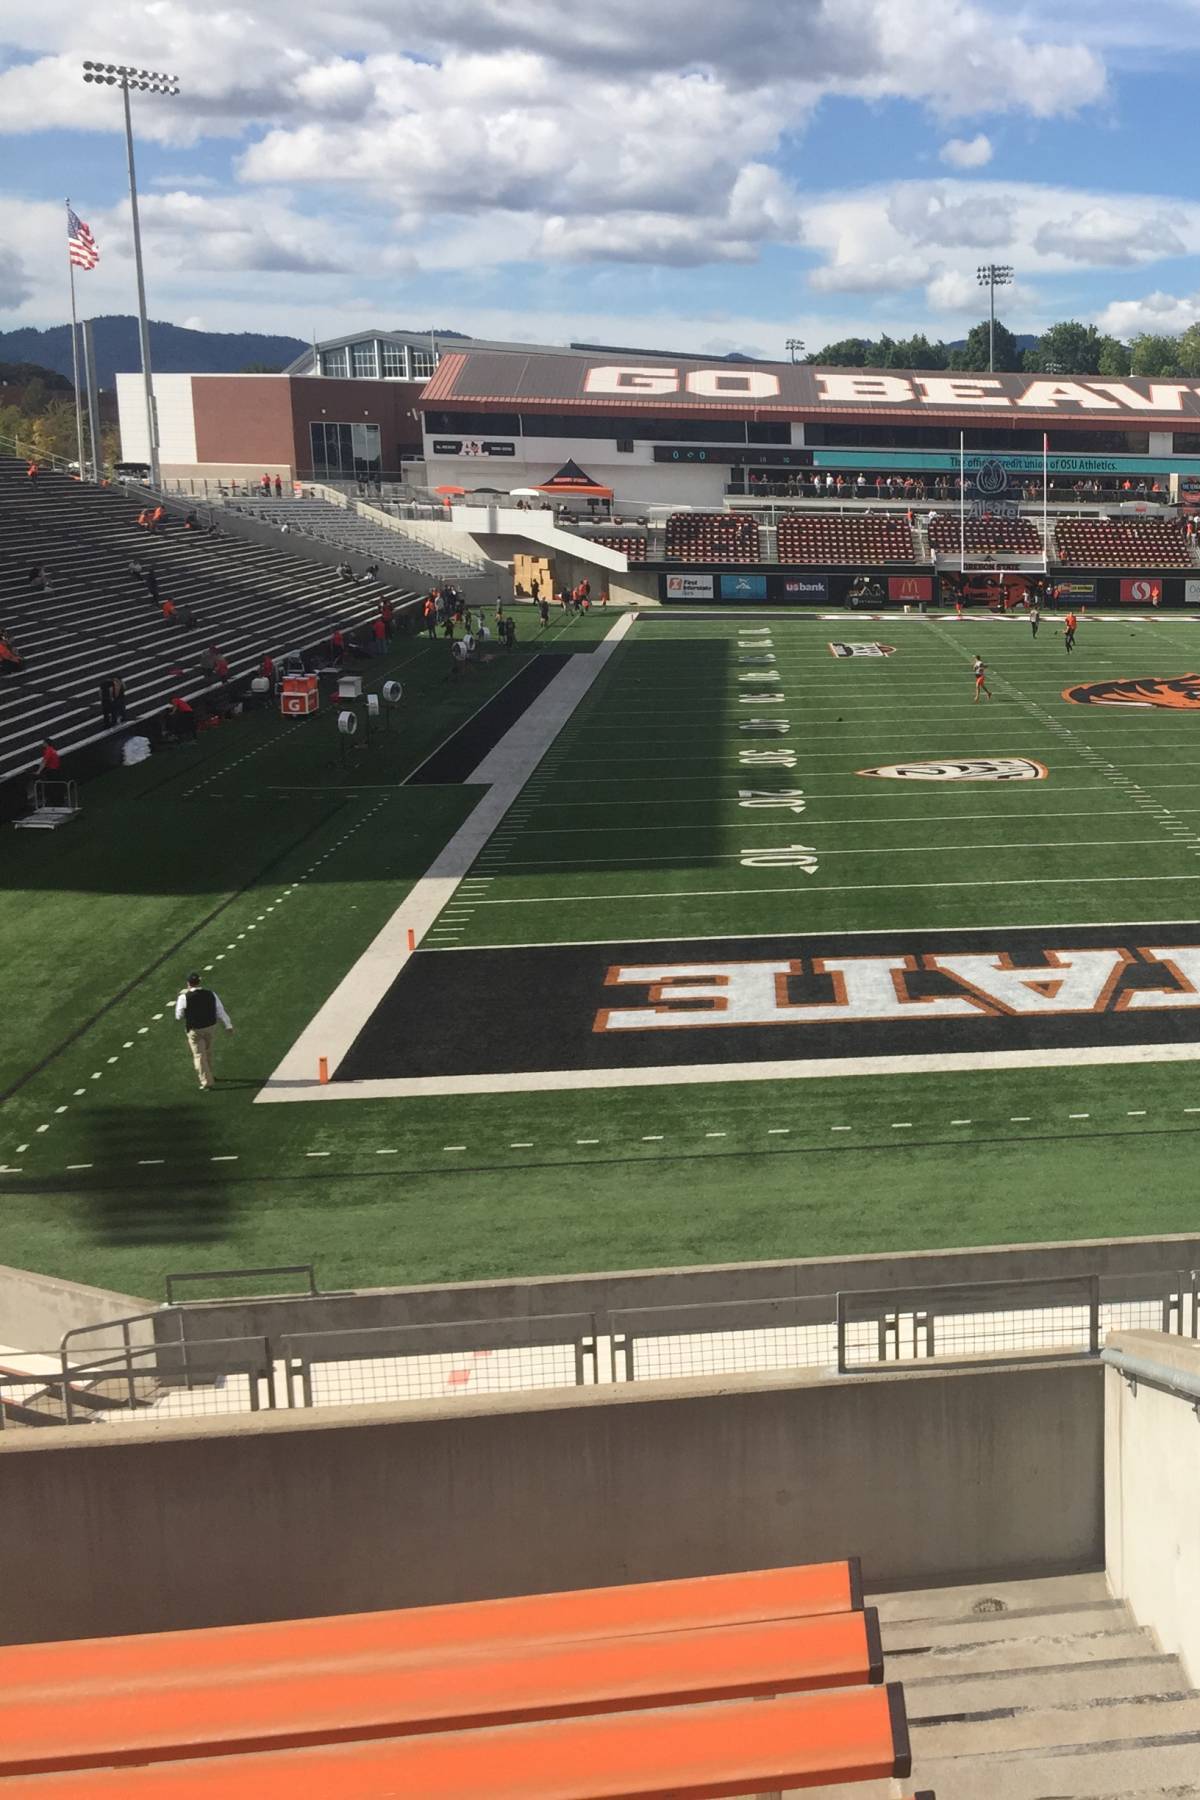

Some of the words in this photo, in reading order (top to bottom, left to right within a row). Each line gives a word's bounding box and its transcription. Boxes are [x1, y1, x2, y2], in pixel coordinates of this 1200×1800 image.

[583, 366, 781, 399] GO
[1050, 459, 1059, 470] of
[1060, 460, 1077, 470] OSU
[1079, 460, 1118, 471] Athletics.
[288, 699, 301, 712] G
